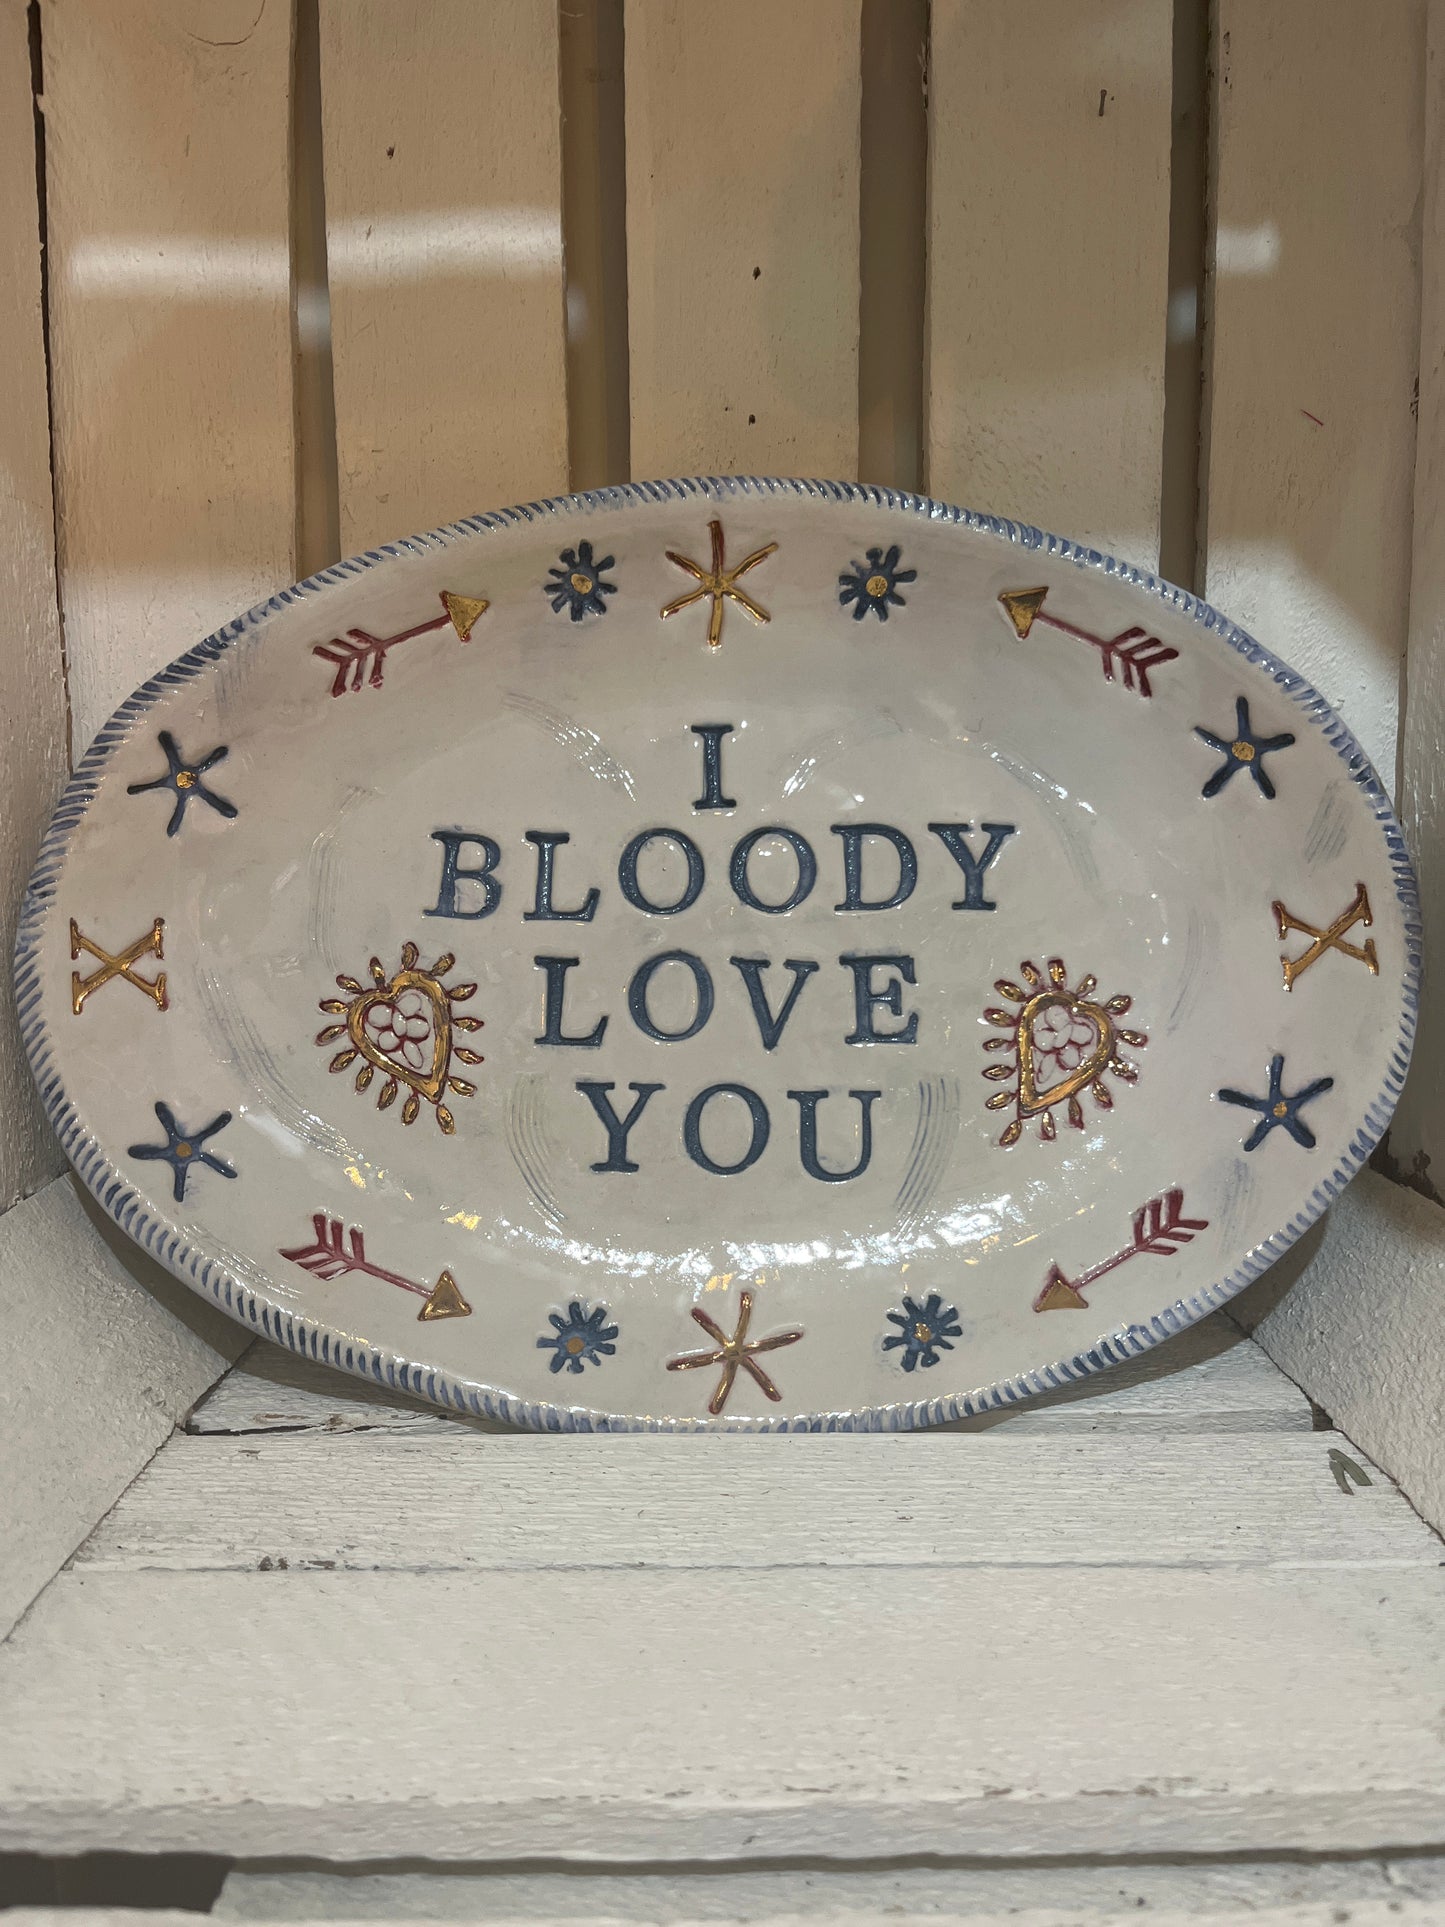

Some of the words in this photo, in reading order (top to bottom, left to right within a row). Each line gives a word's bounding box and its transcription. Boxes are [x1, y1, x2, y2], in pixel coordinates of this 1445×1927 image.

[691, 724, 737, 810] I
[422, 822, 1016, 922] BLOODY
[533, 949, 919, 1051] LOVE
[575, 1081, 882, 1183] YOU
